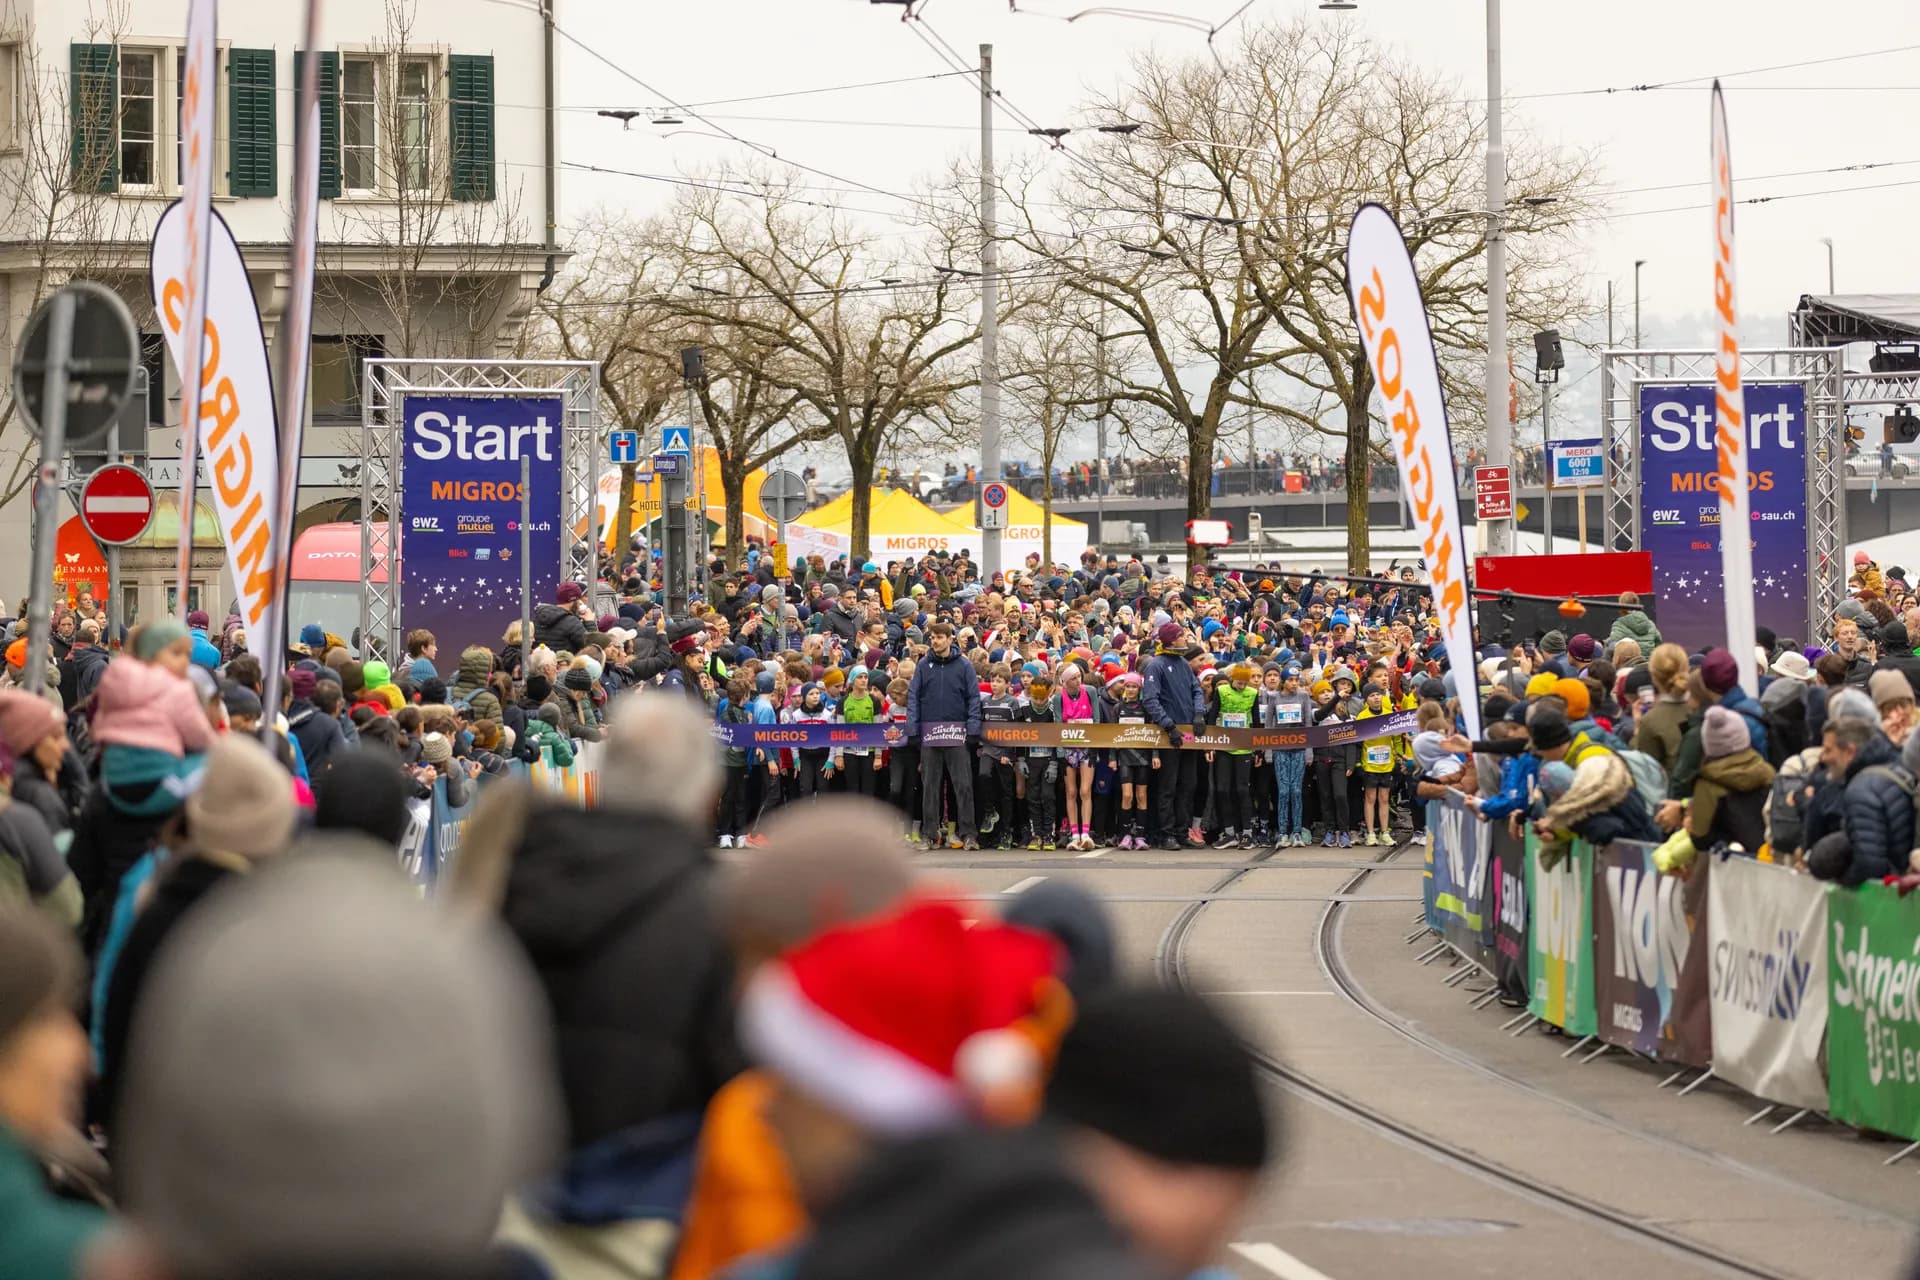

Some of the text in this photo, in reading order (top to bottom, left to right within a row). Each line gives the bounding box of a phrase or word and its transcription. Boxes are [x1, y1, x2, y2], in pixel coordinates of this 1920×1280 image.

[1650, 401, 1796, 452] Strt
[412, 411, 553, 461] Start
[1565, 448, 1593, 457] MERCI
[1567, 457, 1591, 468] 6001
[1671, 471, 1774, 493] MIGOS
[457, 514, 491, 524] groupe
[1652, 509, 1680, 521] ewz
[1761, 510, 1796, 520] sau.ch
[412, 517, 439, 528] ewz
[457, 523, 494, 531] mutuel
[518, 520, 551, 531] su.ch
[1002, 527, 1045, 539] IGRO
[886, 536, 949, 549] MIGROS
[754, 730, 809, 742] MIGROS
[829, 730, 860, 742] Blick
[987, 729, 1040, 741] MIGROS
[1061, 729, 1086, 739] ewz
[1194, 733, 1231, 744] sau.ch
[1252, 733, 1308, 746] MIGROS
